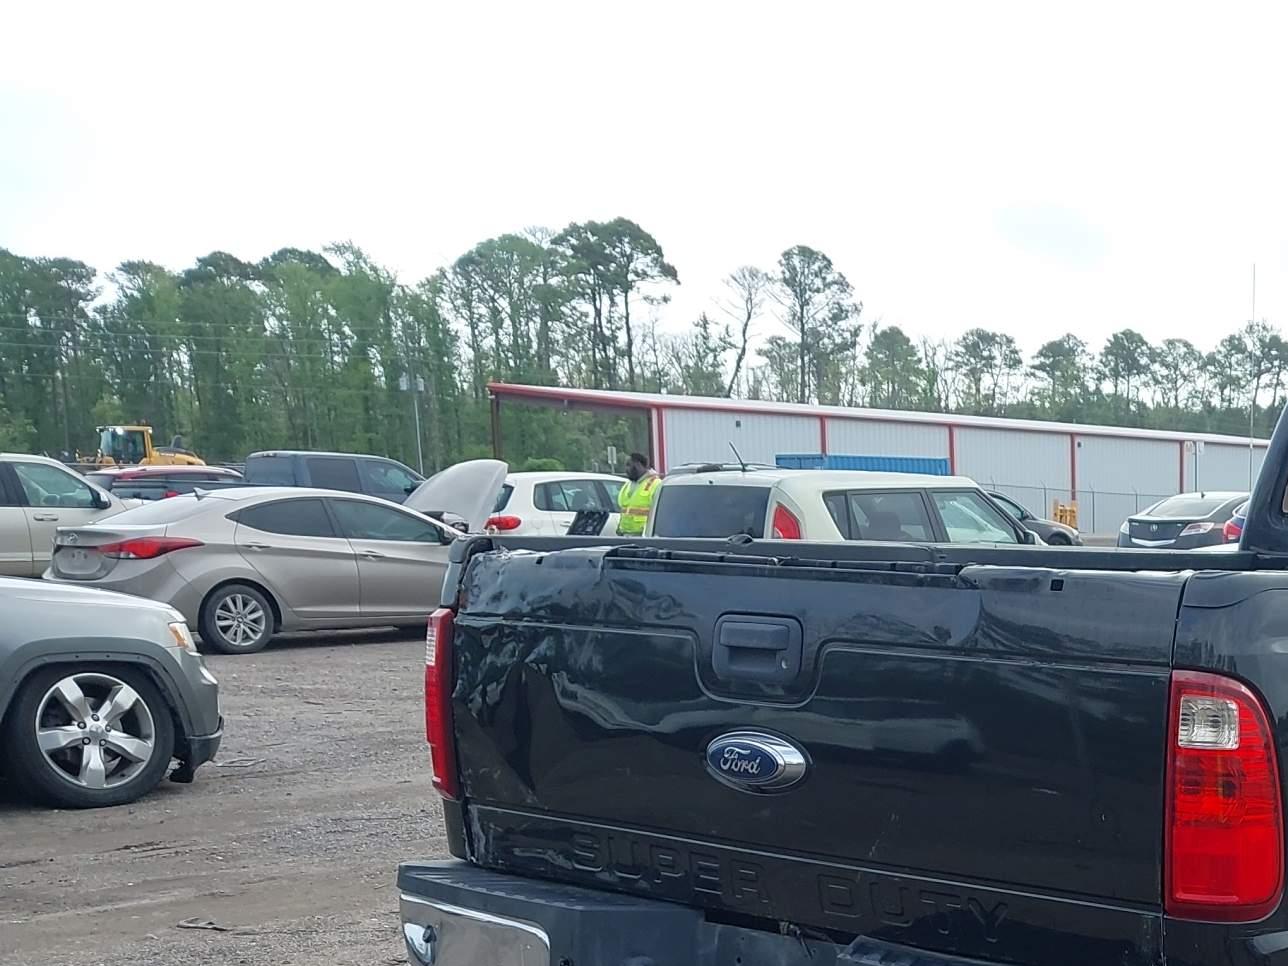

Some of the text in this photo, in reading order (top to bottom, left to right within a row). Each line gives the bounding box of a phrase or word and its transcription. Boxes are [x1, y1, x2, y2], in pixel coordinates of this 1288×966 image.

[720, 746, 761, 775] Ford
[570, 831, 1008, 943] SUPER DUTY
